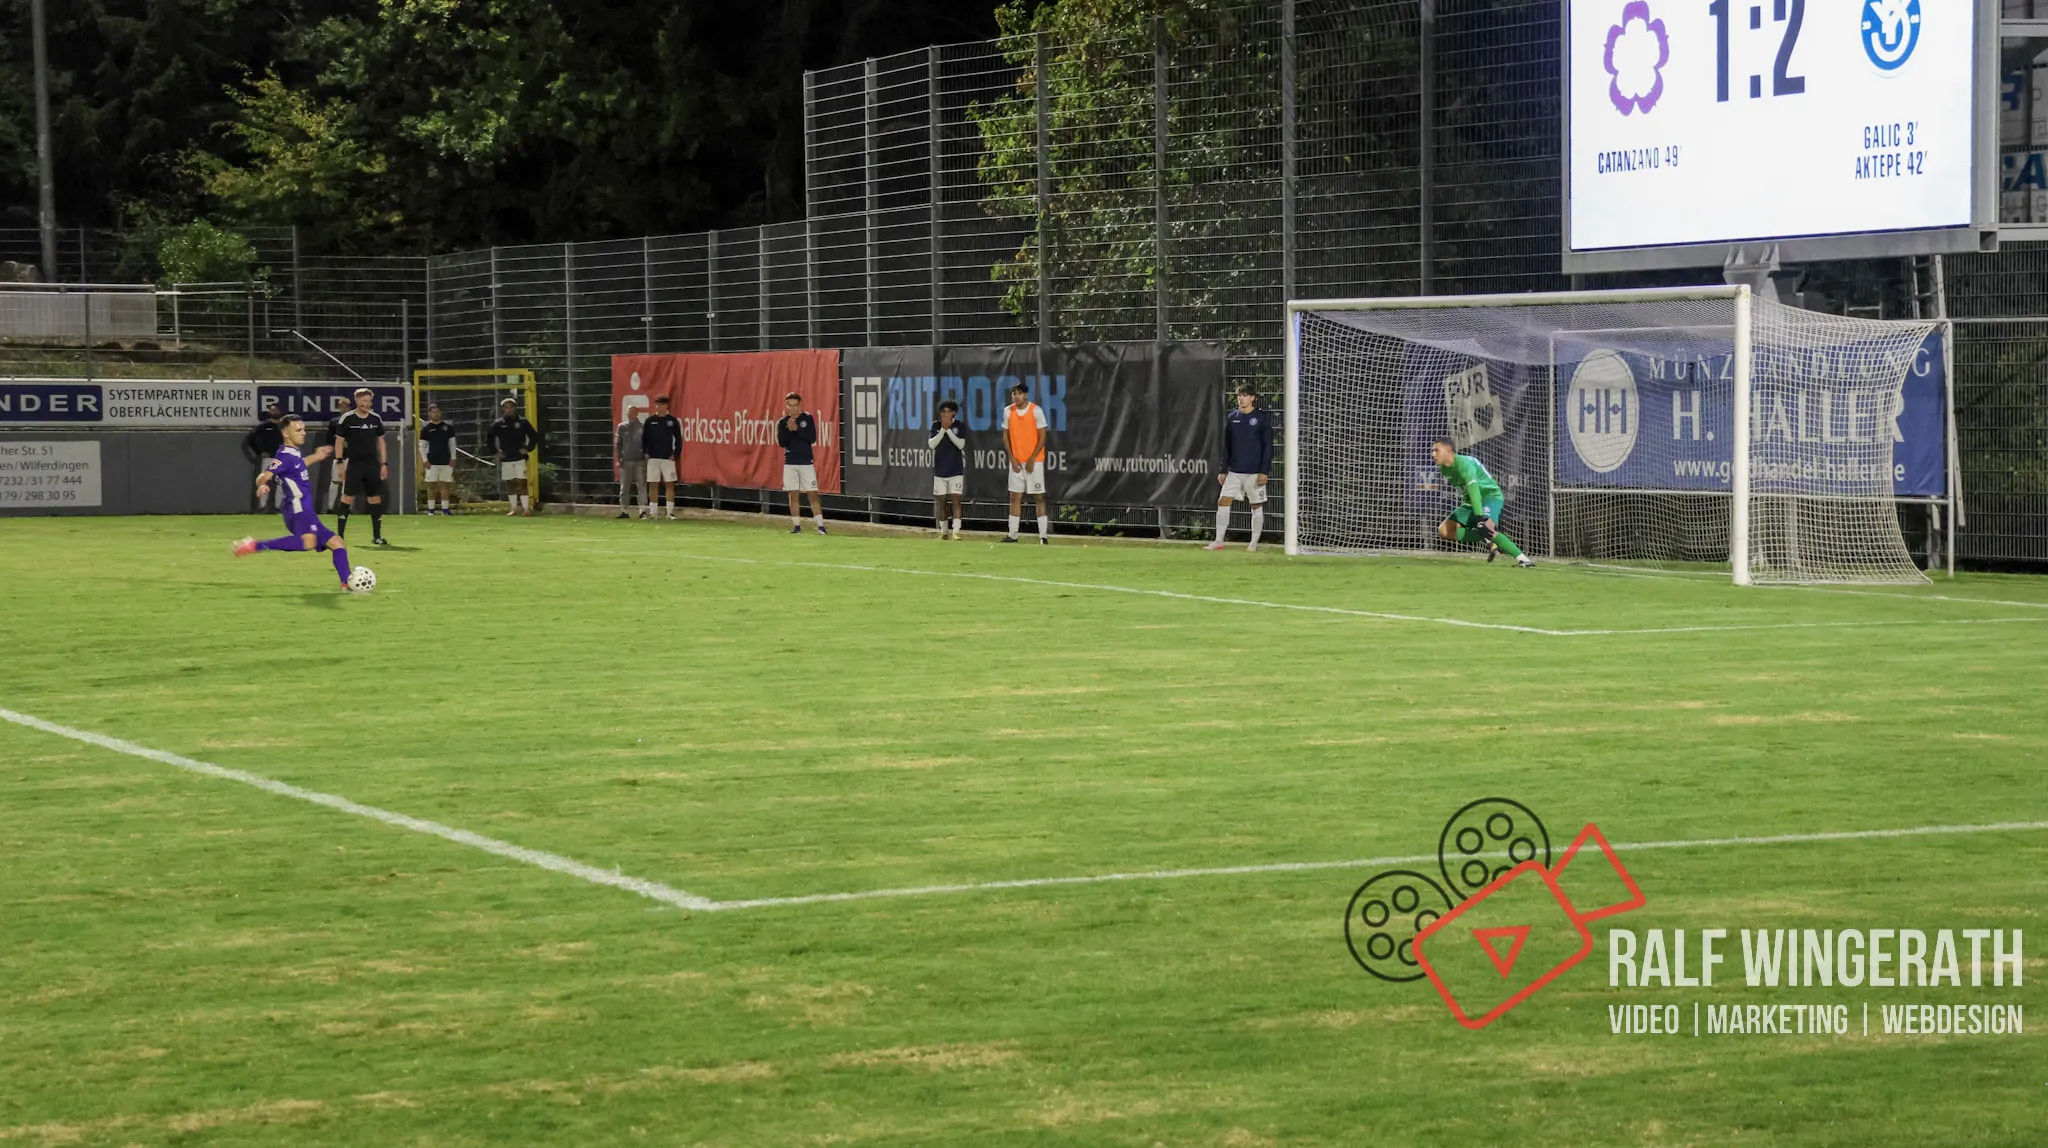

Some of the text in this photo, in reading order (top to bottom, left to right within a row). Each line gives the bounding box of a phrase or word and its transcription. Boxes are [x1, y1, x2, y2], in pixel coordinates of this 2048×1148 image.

[1864, 123, 1900, 149] GALIC
[1598, 147, 1659, 174] CATANZANO
[1855, 152, 1901, 180] AKTEPE
[109, 389, 251, 401] SYSTEMPARTNER IN DER
[109, 404, 252, 418] OBERFLÄCHENTECHNIK
[1673, 390, 1714, 441] H.
[21, 446, 39, 456] Str.
[41, 446, 53, 456] 51
[1094, 454, 1208, 474] www.rutronik.com
[46, 476, 60, 486] 77
[62, 475, 82, 485] 444
[48, 490, 60, 501] 30
[62, 490, 76, 501] 95
